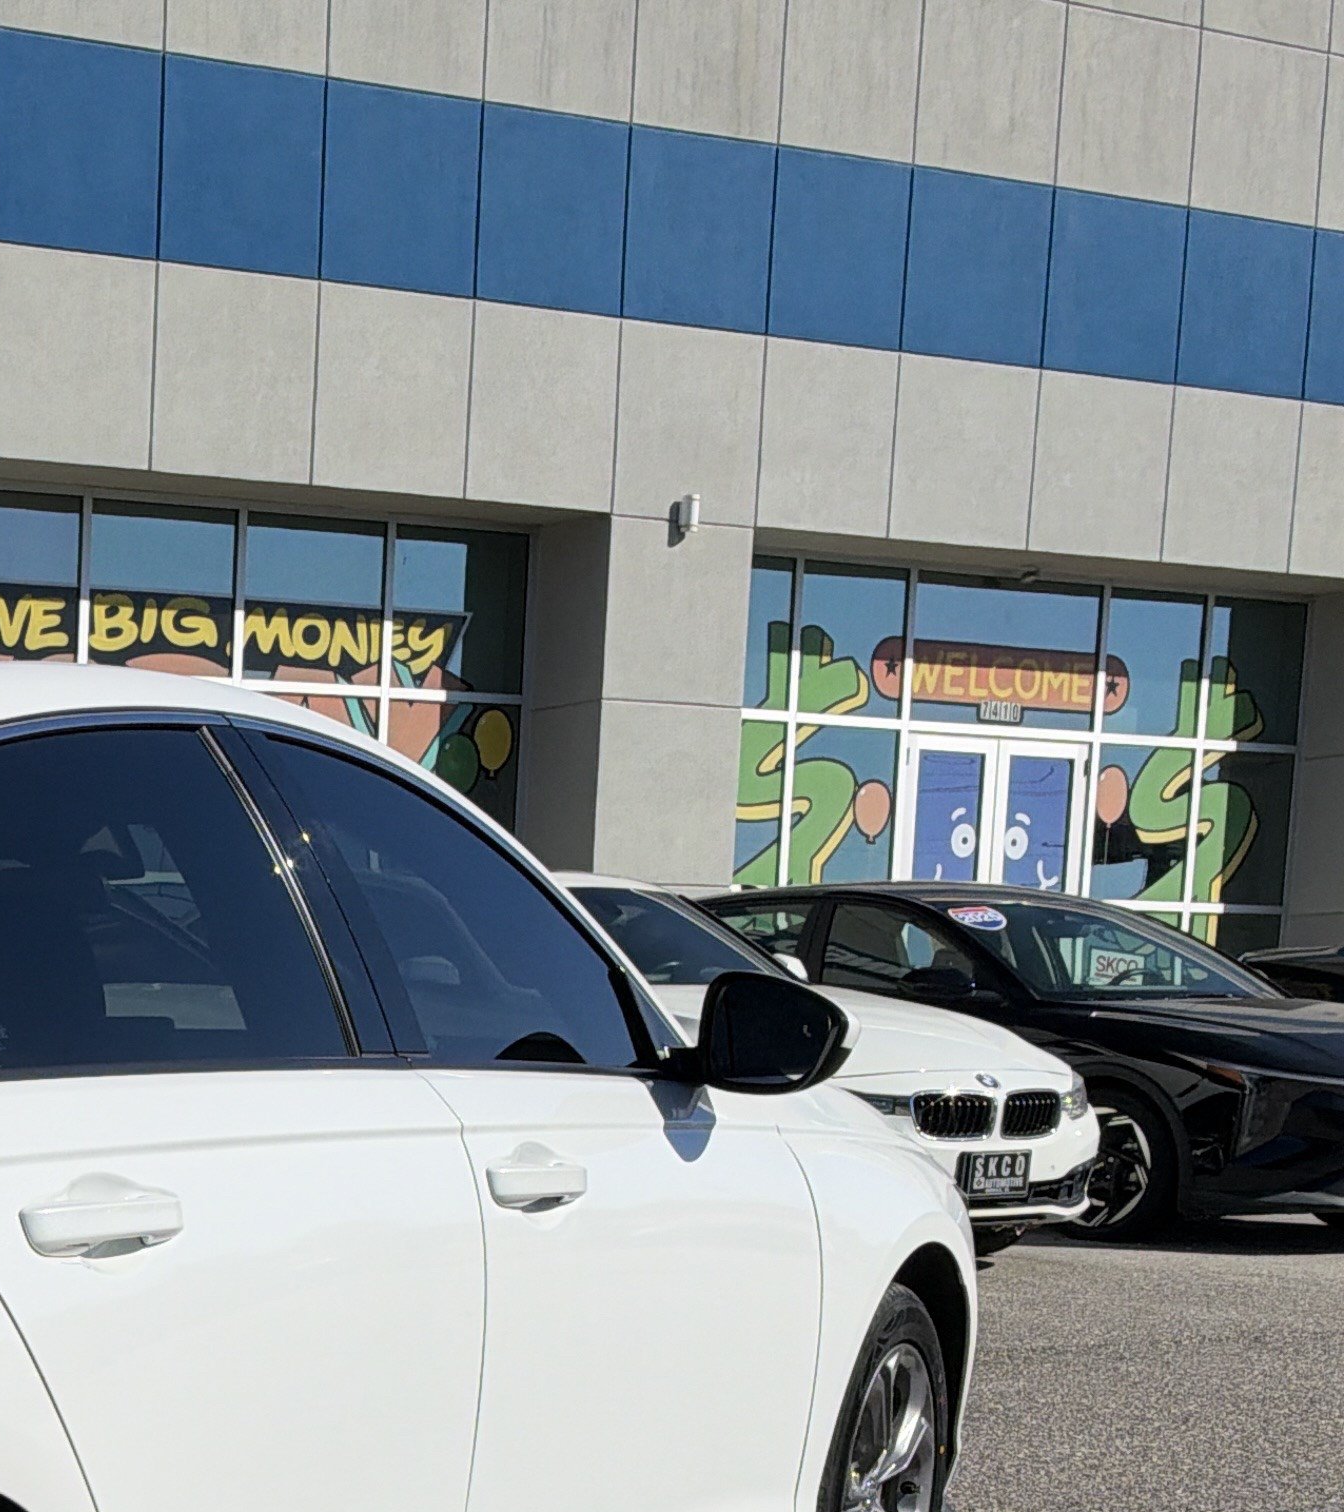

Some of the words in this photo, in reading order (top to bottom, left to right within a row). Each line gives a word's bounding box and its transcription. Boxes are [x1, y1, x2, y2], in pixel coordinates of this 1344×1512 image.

[88, 593, 219, 650] BIG
[226, 606, 454, 675] MONEY
[911, 650, 1095, 704] WELCOME
[980, 701, 1022, 722] 7410
[974, 1155, 1026, 1178] SKCO
